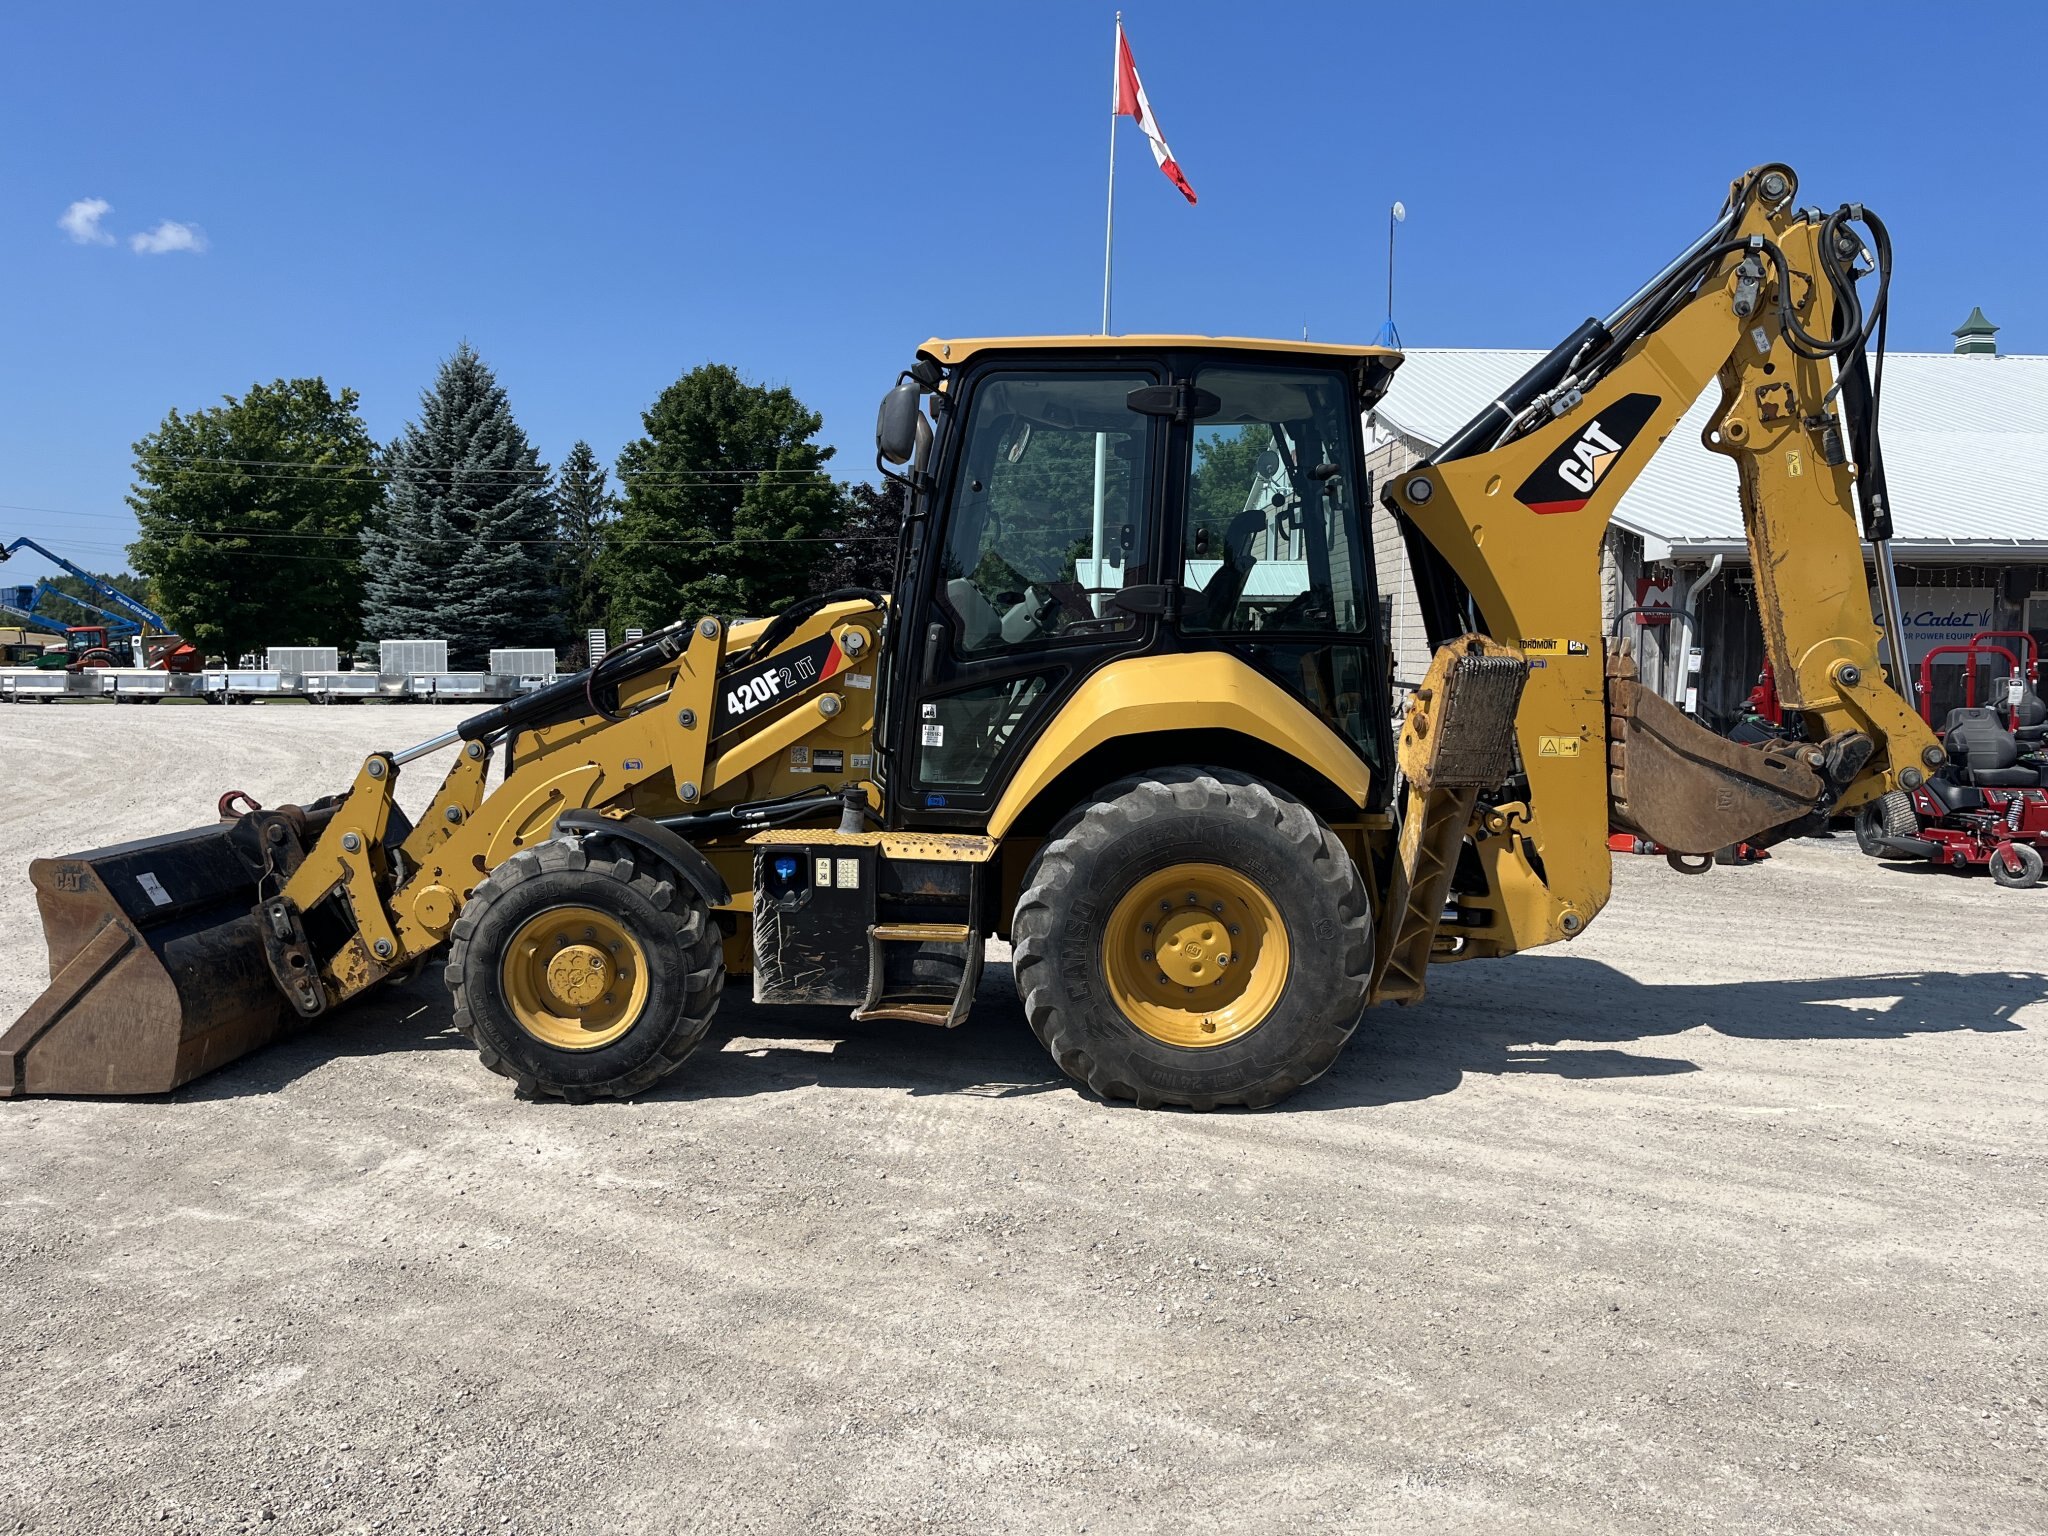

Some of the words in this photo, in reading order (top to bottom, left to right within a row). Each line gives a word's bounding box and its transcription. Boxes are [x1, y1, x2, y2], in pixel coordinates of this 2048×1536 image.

[1558, 420, 1622, 493] CAT
[1874, 611, 1911, 626] Cb
[1914, 611, 1979, 627] Cadet
[1915, 632, 1945, 640] POWER
[1946, 632, 1992, 640] EQUIPM
[1518, 640, 1558, 650] TOROMONT
[1569, 640, 1585, 651] CAT
[795, 655, 816, 680] IT
[55, 873, 81, 891] CAT
[1060, 900, 1098, 1004] CAMSO
